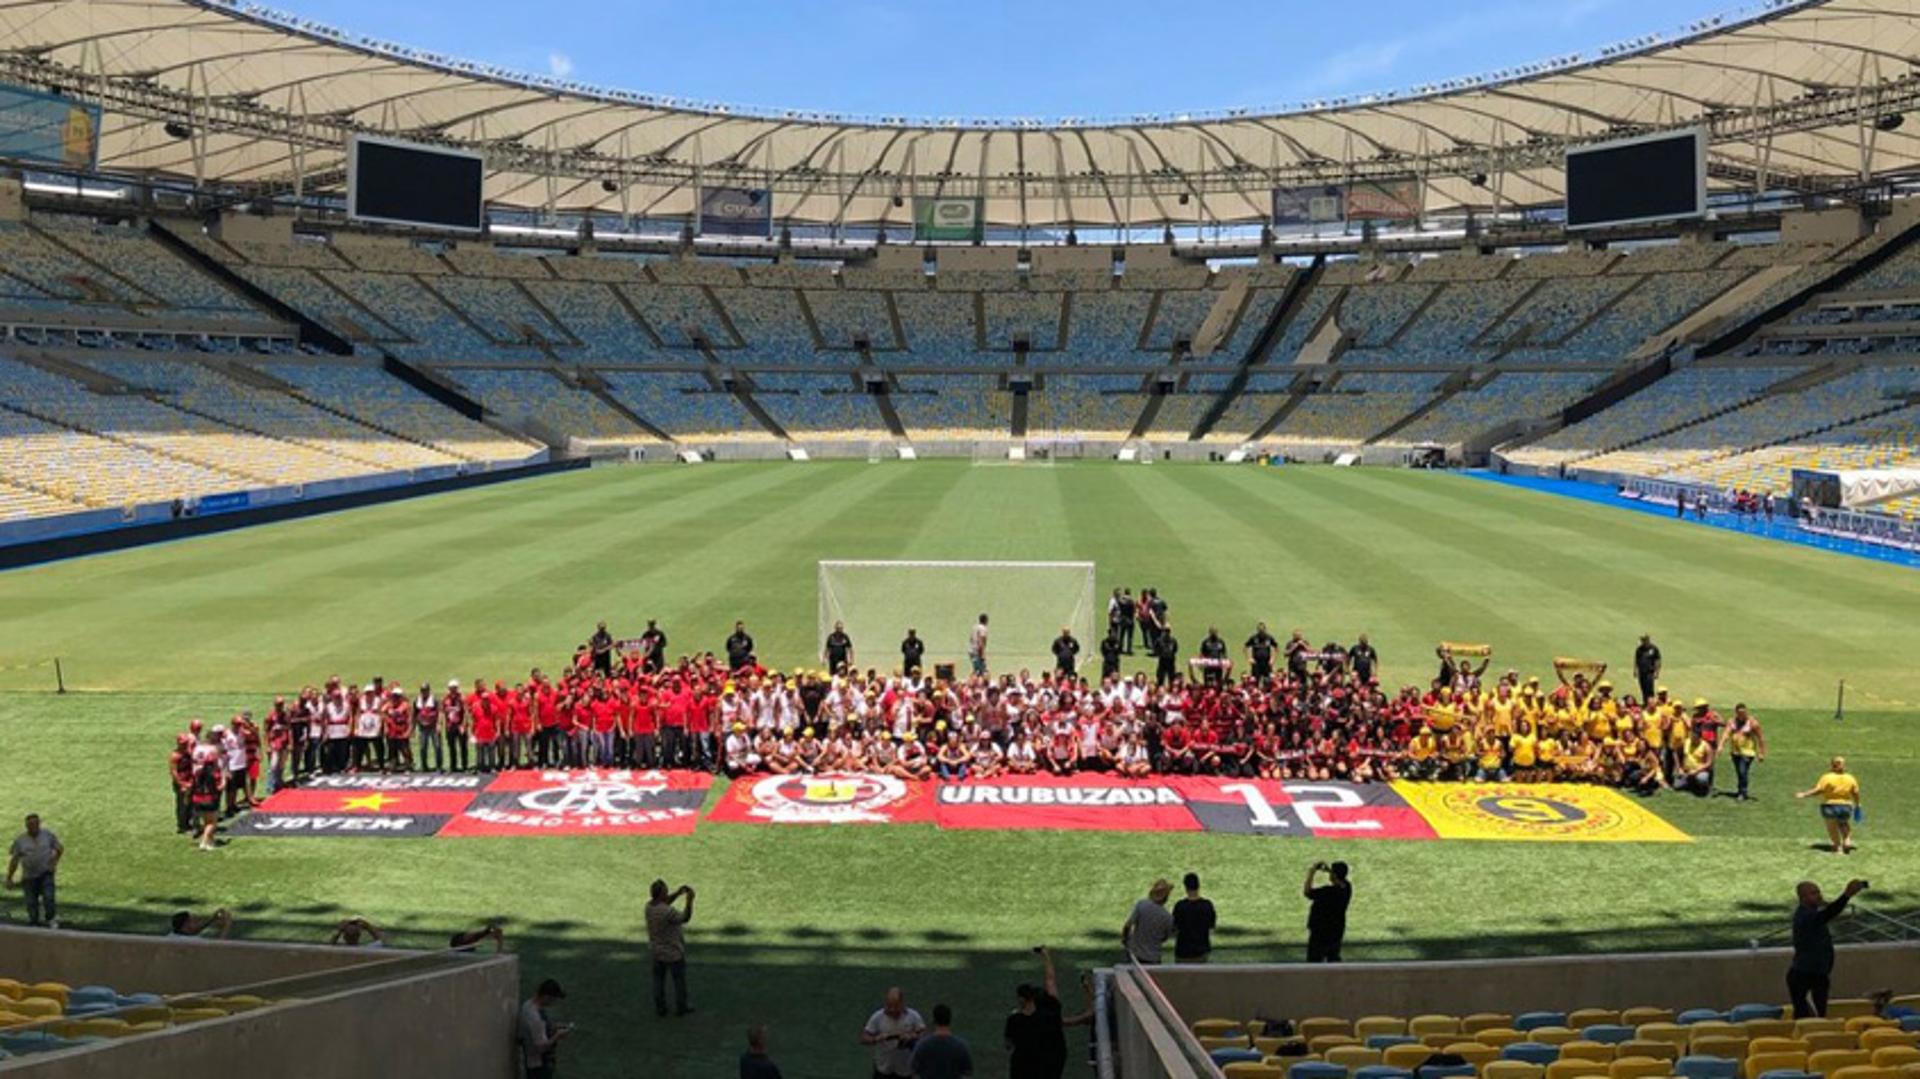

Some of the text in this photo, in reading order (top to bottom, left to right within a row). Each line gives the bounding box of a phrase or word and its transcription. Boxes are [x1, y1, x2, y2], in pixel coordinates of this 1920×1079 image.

[941, 785, 1186, 804] URUBUZADA
[1220, 783, 1383, 829] 12
[255, 816, 414, 830] JOVEM
